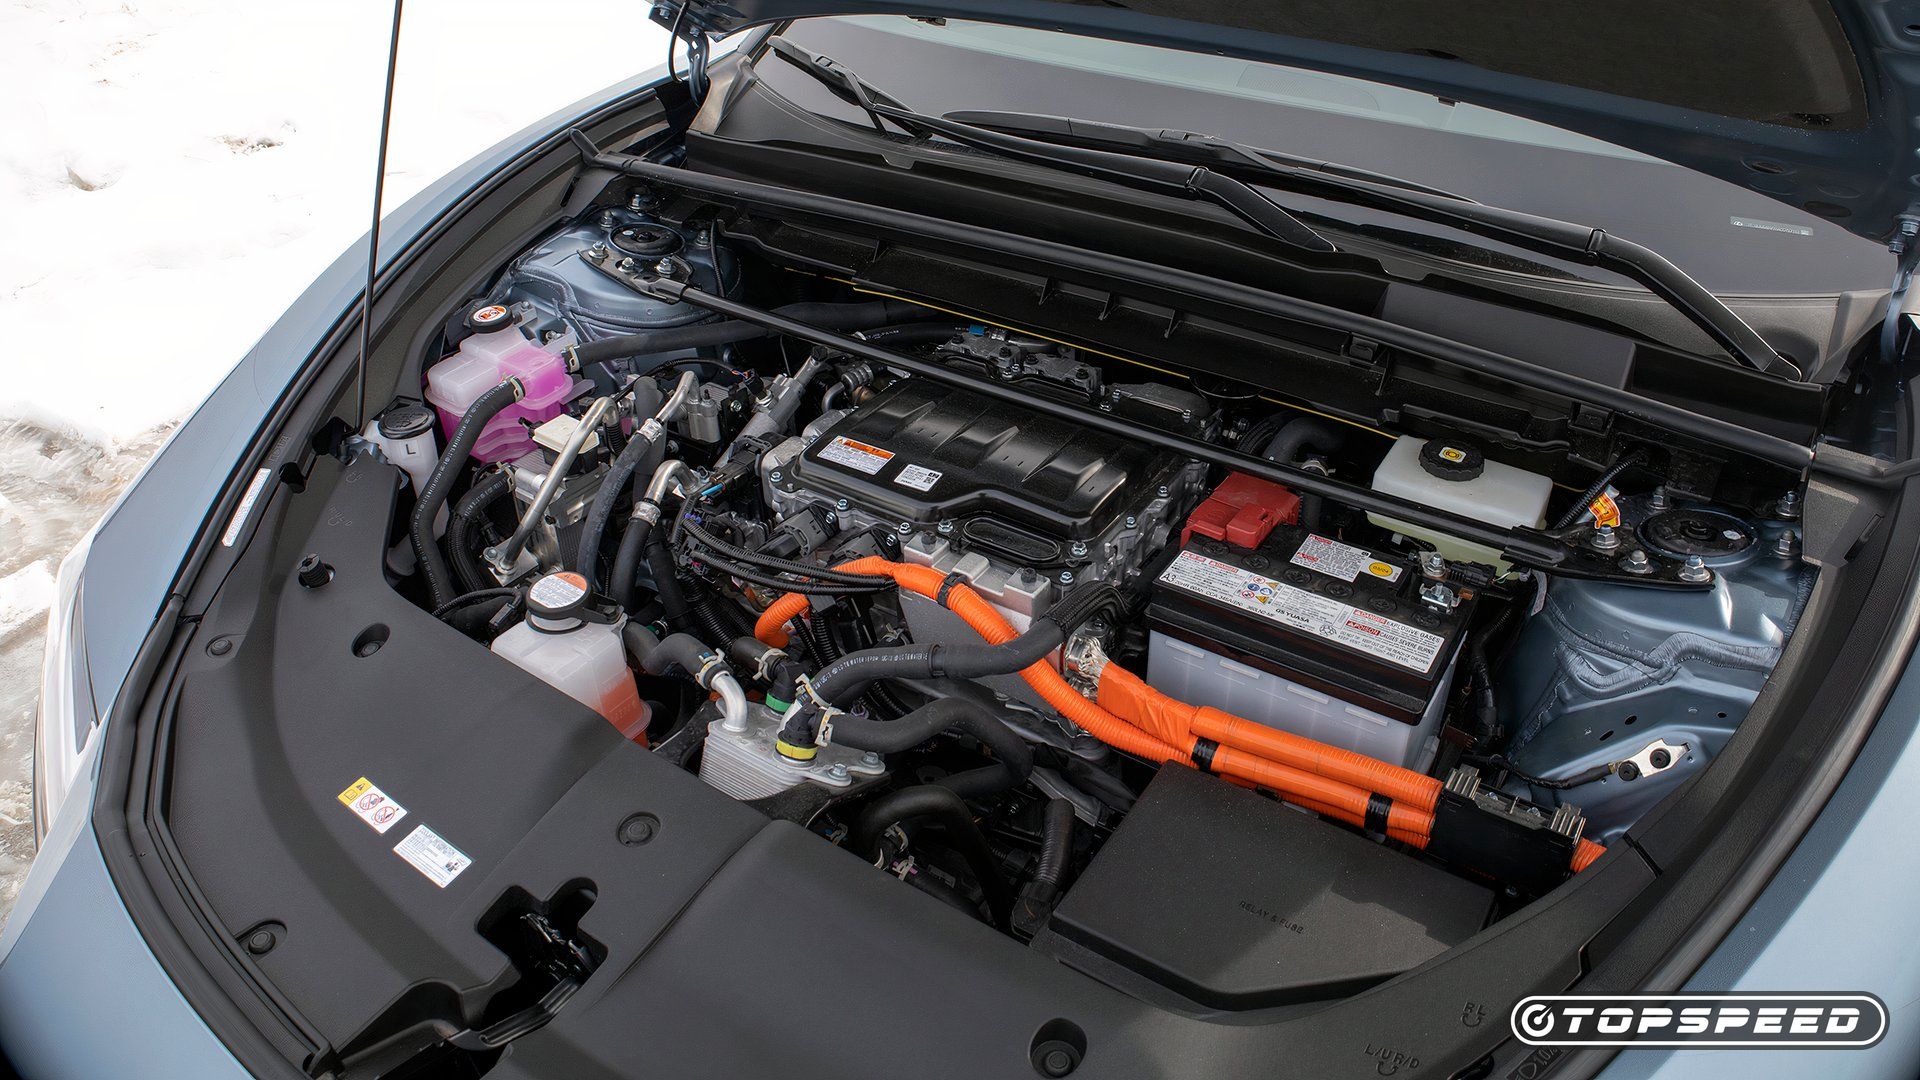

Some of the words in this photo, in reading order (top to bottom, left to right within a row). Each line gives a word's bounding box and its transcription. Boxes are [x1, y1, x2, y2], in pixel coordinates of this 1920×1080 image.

[1161, 573, 1177, 582] A3
[1286, 611, 1310, 623] YUASA
[1361, 611, 1386, 624] DANGER
[1386, 620, 1419, 636] EXPLOSIVE
[1355, 624, 1380, 636] POISON
[1380, 631, 1399, 643] CAUSES
[1399, 639, 1417, 649] SEVERE
[1417, 645, 1435, 655] BURNS
[1239, 900, 1269, 918] RELAY
[1279, 918, 1304, 934] FUSE
